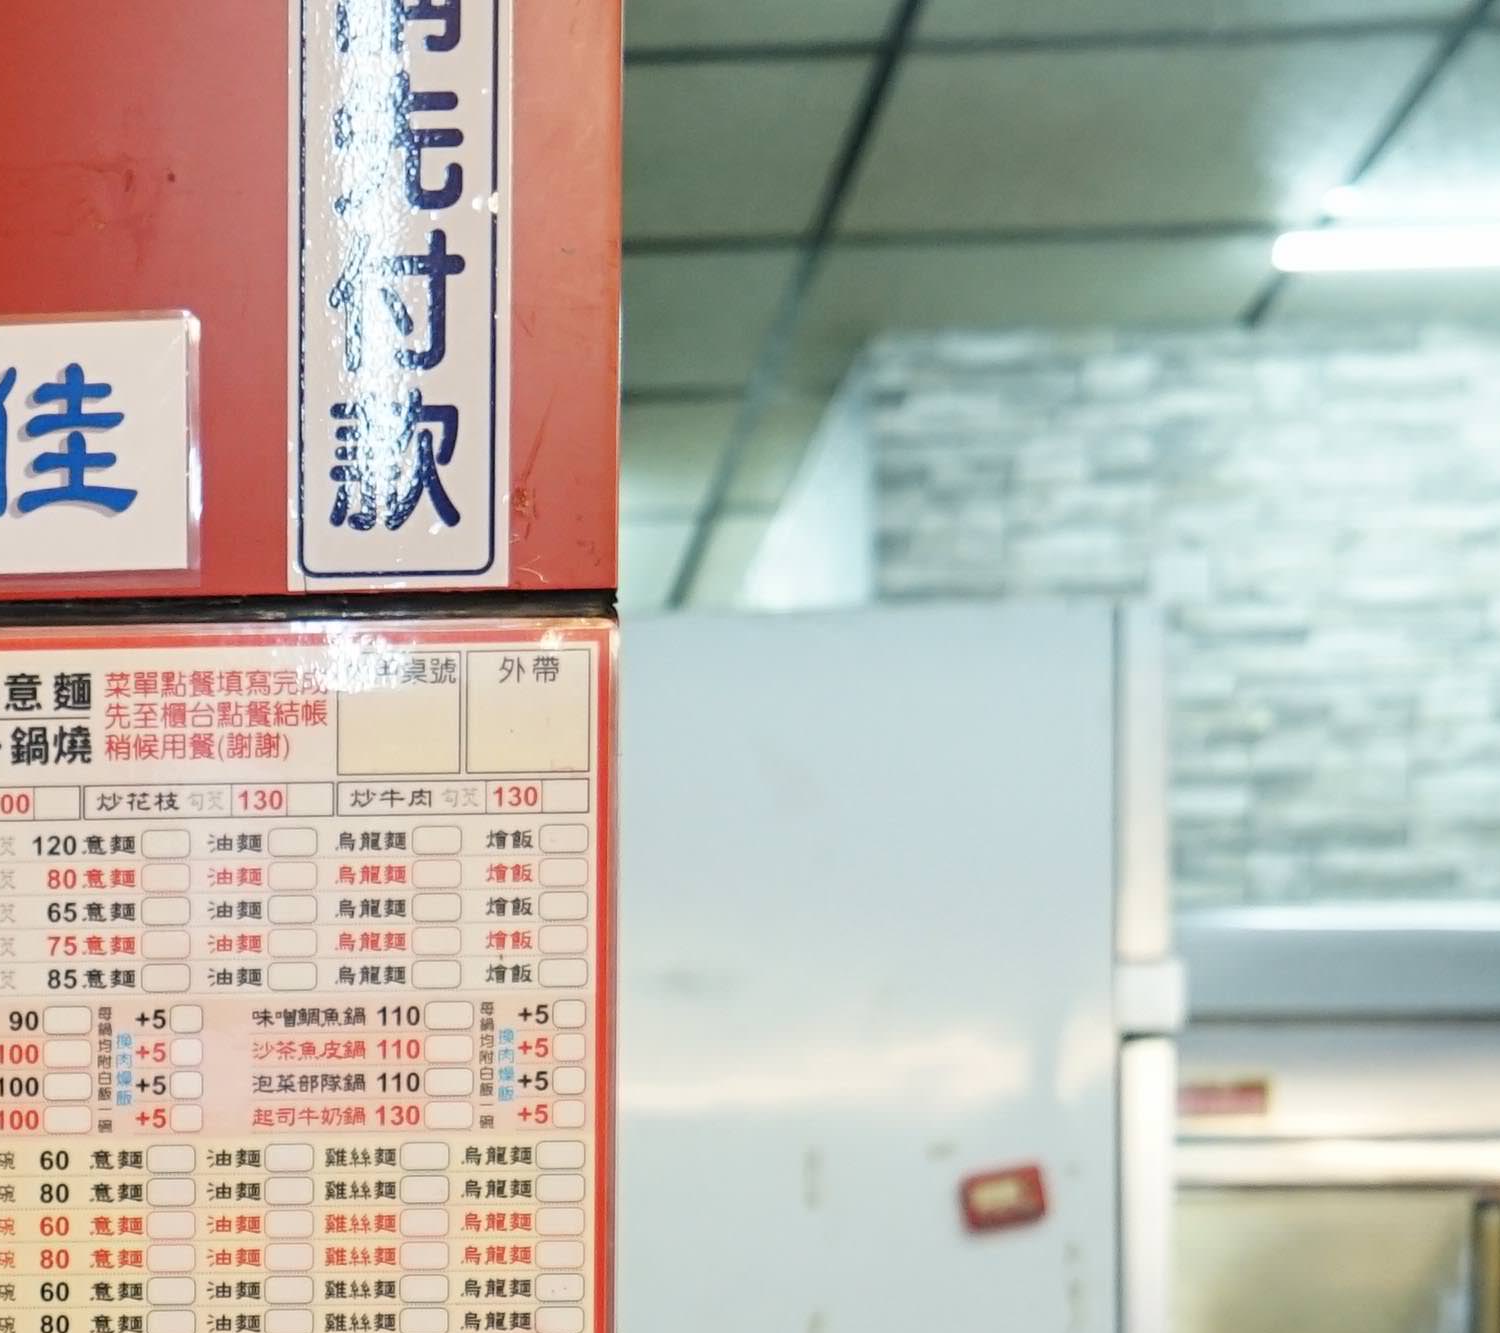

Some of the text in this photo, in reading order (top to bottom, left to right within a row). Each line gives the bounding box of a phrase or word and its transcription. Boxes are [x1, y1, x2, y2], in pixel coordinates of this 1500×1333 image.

[330, 0, 466, 532] 先付款
[500, 656, 560, 684] 外帶
[103, 700, 328, 732] 先至櫃台點餐結帳
[40, 1151, 70, 1171] 60
[40, 1184, 70, 1204] 80
[90, 1183, 144, 1203] 意麵
[207, 1182, 262, 1202] 油麵
[461, 1180, 532, 1200] 烏龍麵
[40, 1217, 70, 1237] 60
[40, 1249, 70, 1269] 80
[40, 1282, 70, 1302] 60
